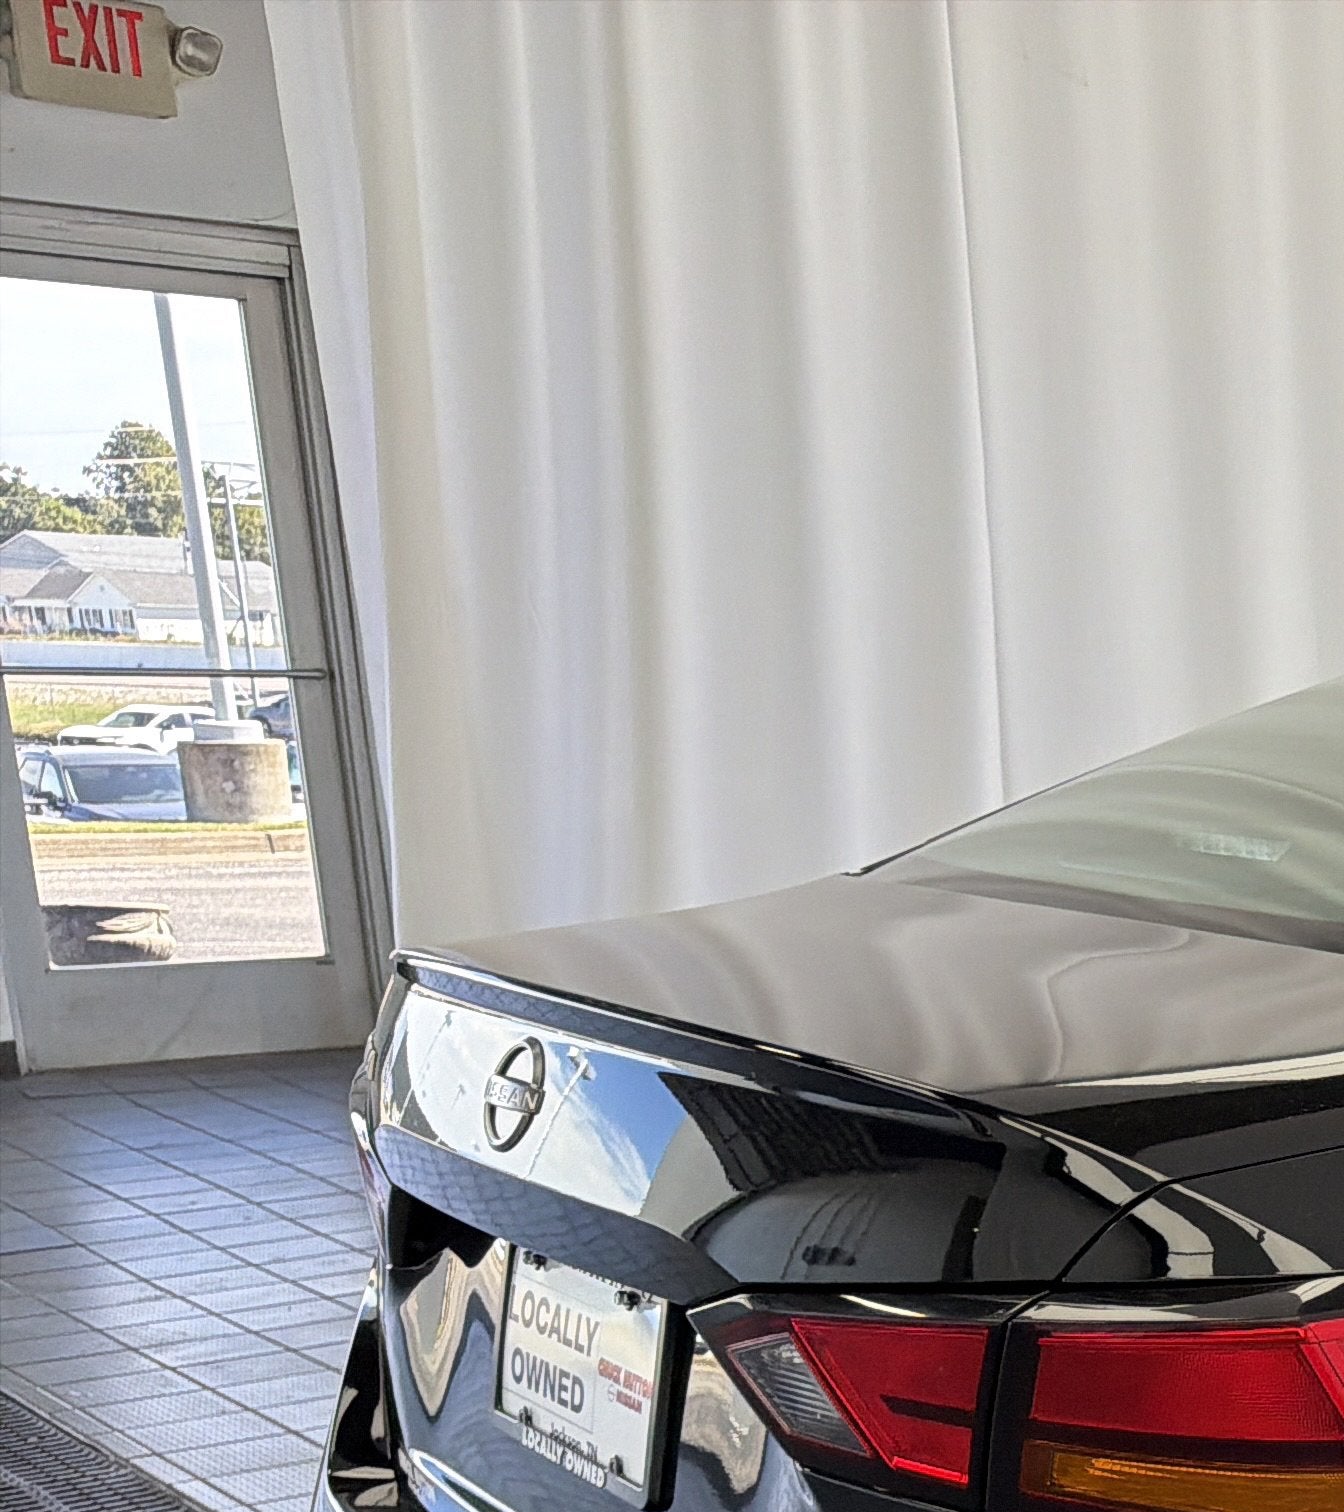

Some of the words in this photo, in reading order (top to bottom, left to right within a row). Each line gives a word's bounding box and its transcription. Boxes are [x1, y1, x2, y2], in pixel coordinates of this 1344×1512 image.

[43, 0, 143, 78] EXIT
[508, 1283, 600, 1357] LOCALLY
[511, 1347, 585, 1414] OWNED
[521, 1425, 564, 1465] LOCALLY
[565, 1447, 606, 1488] OWNED
